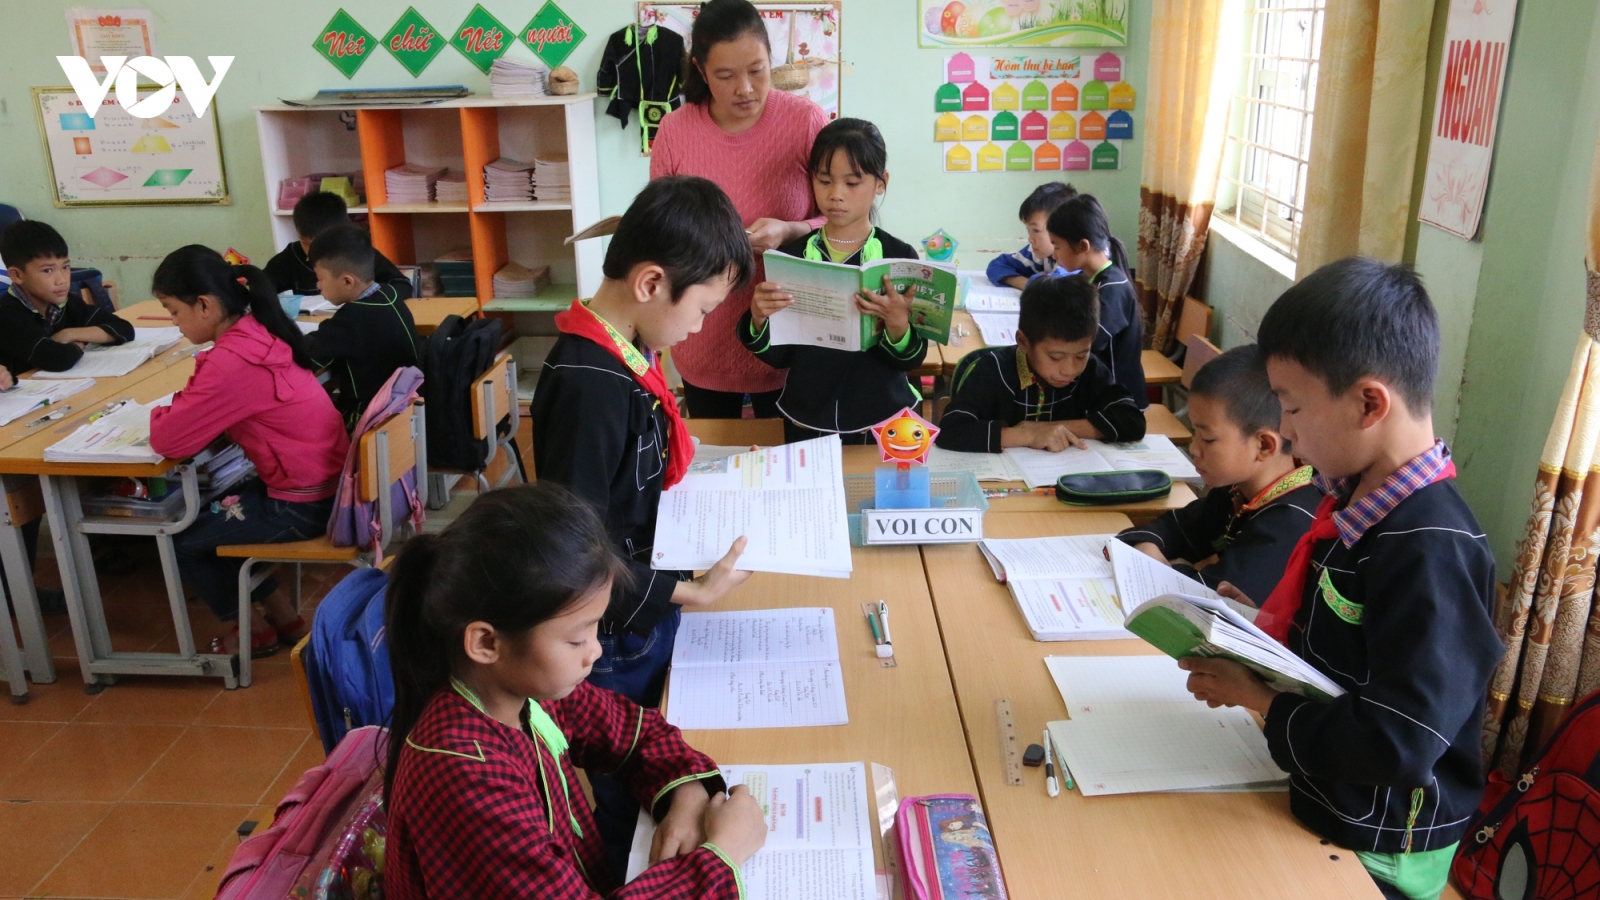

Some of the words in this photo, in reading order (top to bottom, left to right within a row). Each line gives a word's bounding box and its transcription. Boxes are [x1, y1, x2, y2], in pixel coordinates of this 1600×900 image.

[324, 31, 366, 58] Nét
[390, 24, 435, 53] chữ
[460, 27, 503, 54] Nết
[526, 19, 573, 53] người
[994, 58, 1020, 71] Hòm
[1437, 39, 1506, 148] NGOAN
[915, 285, 935, 296] IỆT
[932, 292, 947, 306] 4
[875, 518, 918, 536] VOI
[924, 517, 973, 535] CON
